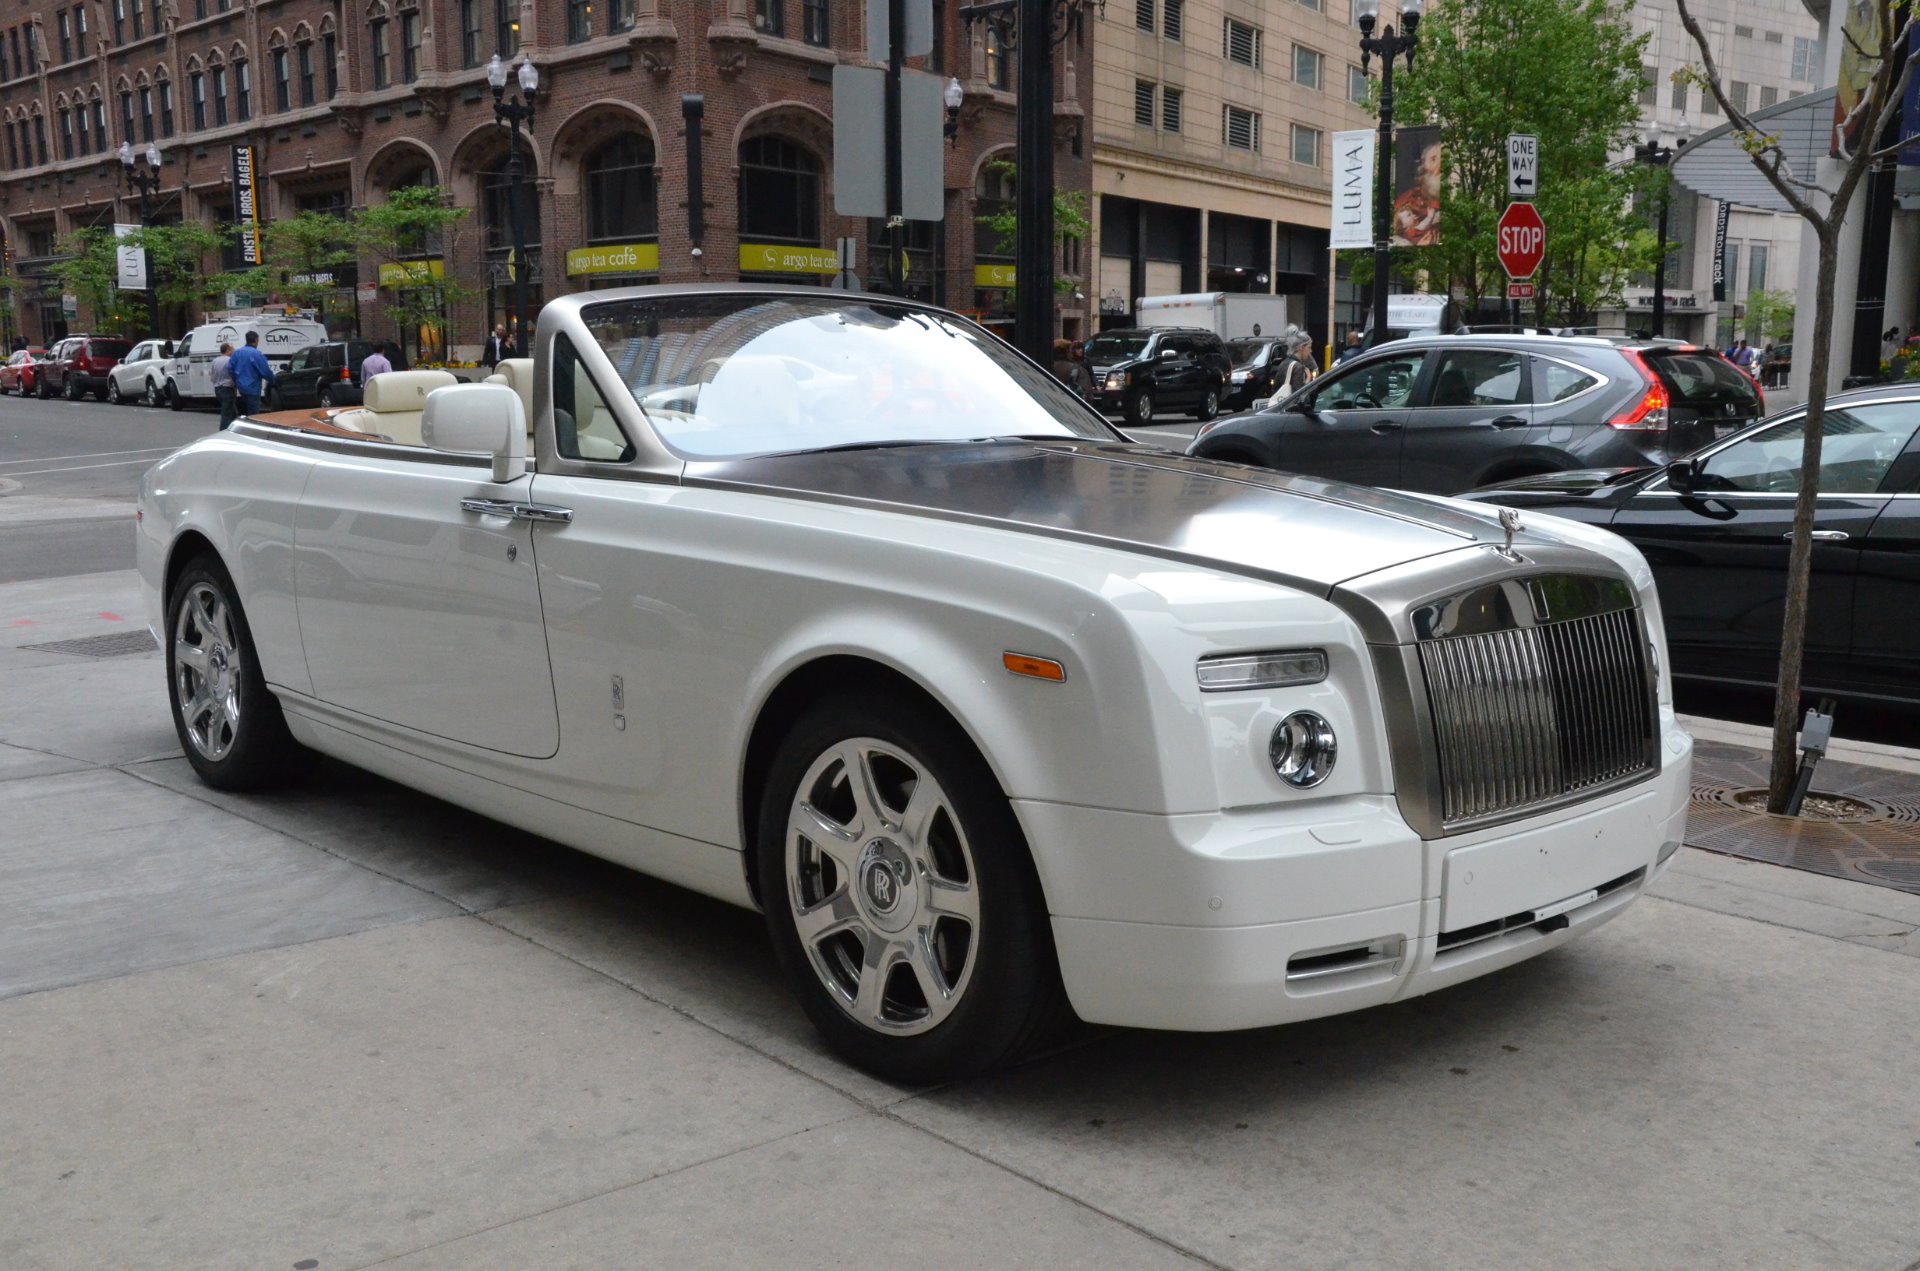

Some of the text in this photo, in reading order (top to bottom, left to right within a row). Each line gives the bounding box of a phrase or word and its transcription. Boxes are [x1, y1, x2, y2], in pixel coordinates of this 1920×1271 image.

[1512, 140, 1533, 154] ONE
[237, 147, 251, 186] BAGELS
[1511, 157, 1534, 171] WAY
[1342, 145, 1364, 225] LUMA
[1501, 226, 1542, 255] STOP
[592, 252, 606, 267] tea
[609, 246, 637, 266] café
[783, 254, 808, 270] argo
[810, 254, 823, 268] tea
[1713, 259, 1724, 284] rack
[1510, 285, 1532, 296] ALL WAY
[266, 334, 289, 343] CLM
[176, 363, 190, 376] CLM
